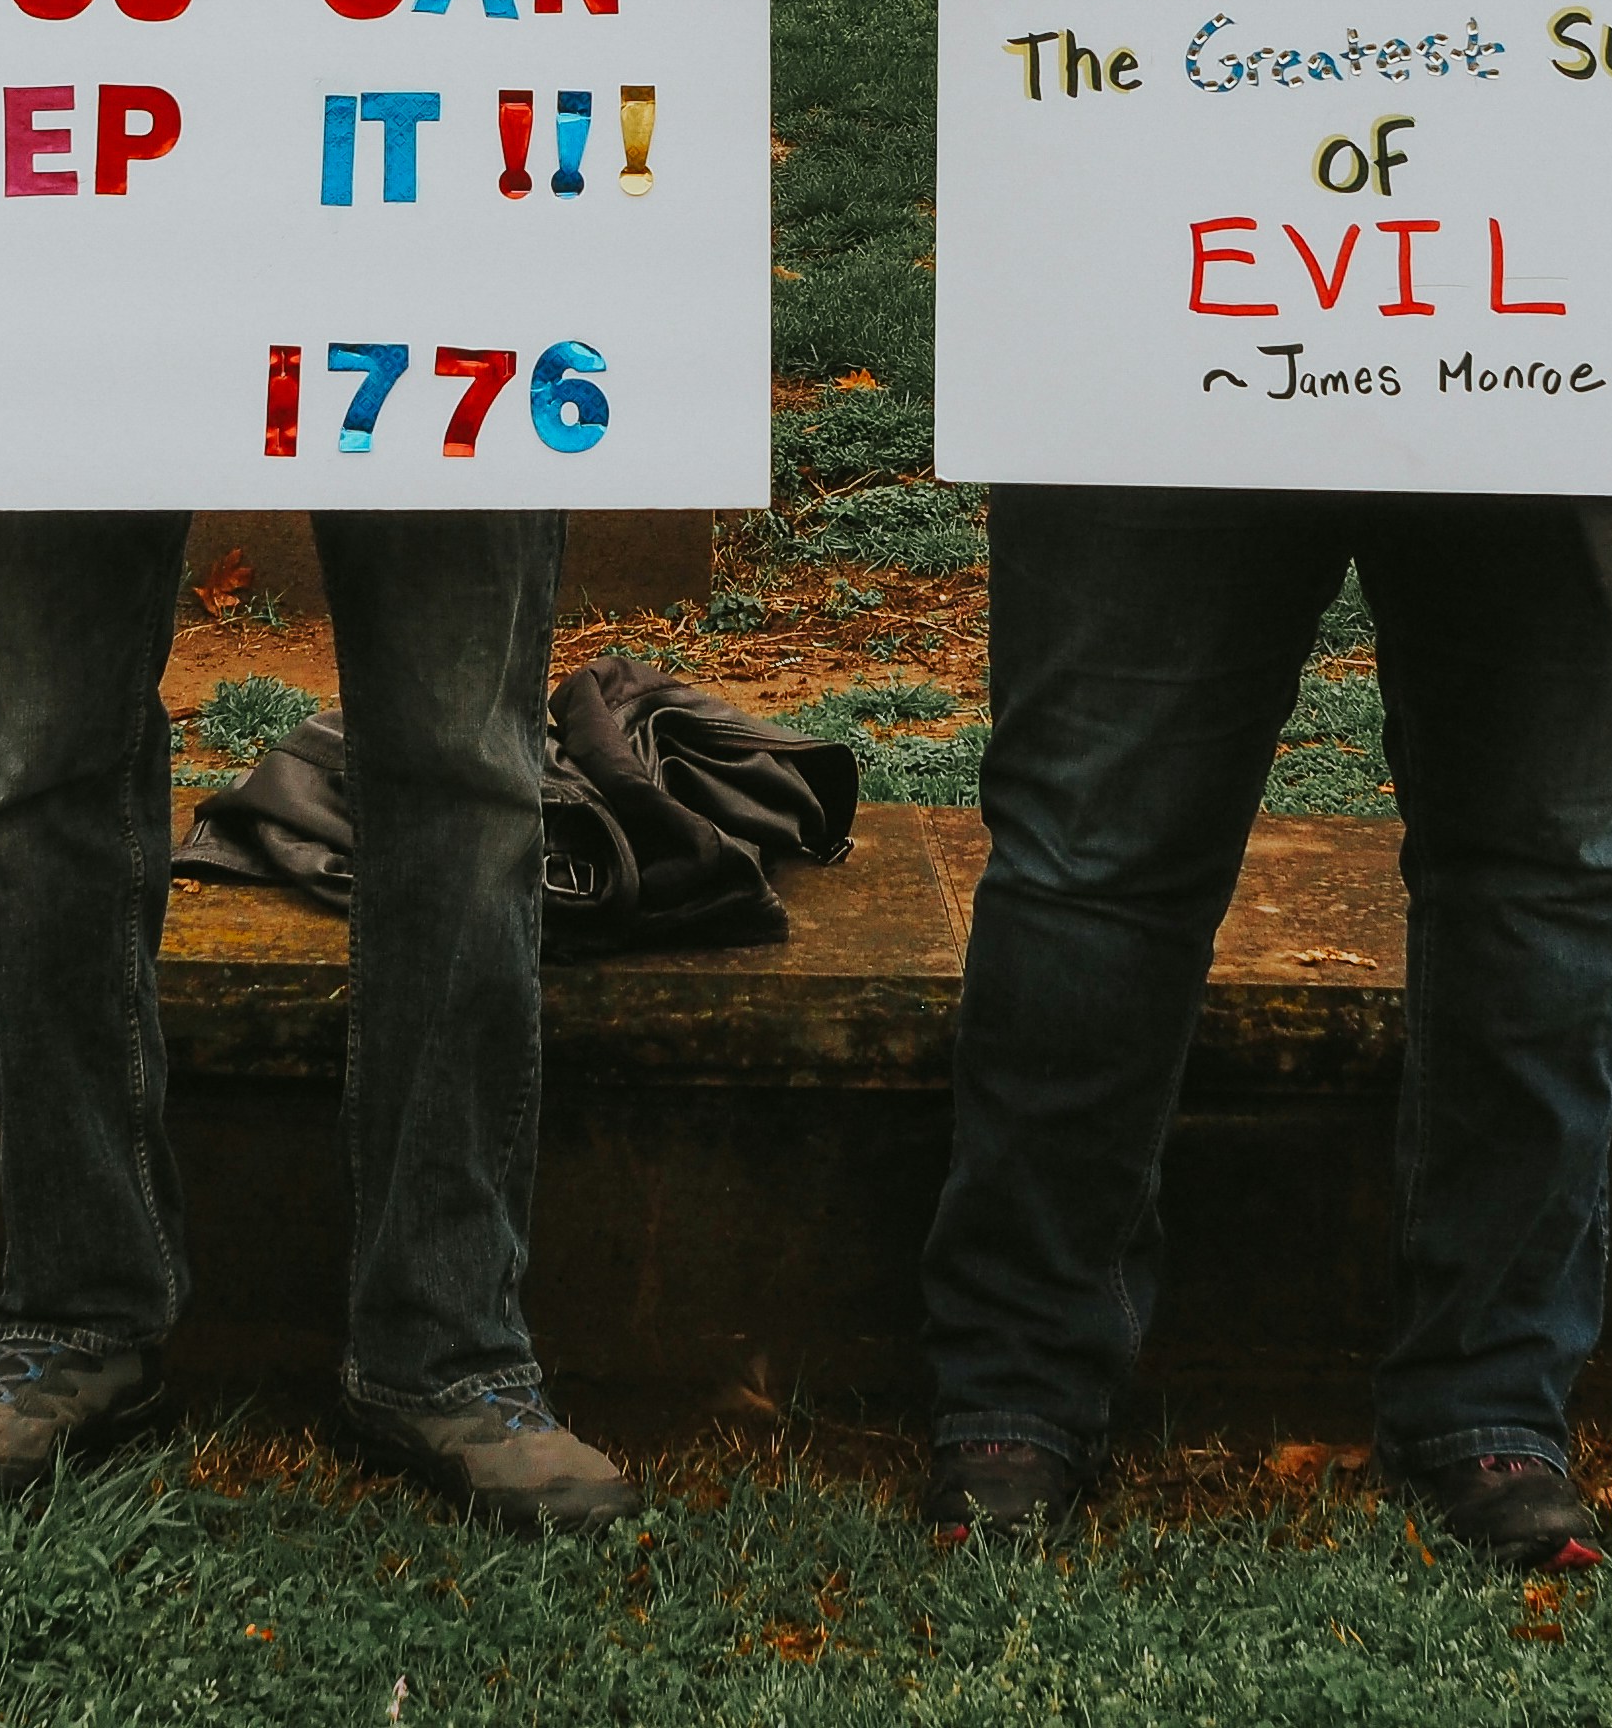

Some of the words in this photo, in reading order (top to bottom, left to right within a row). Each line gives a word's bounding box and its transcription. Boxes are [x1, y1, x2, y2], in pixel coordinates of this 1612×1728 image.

[1004, 28, 1143, 102] The
[1185, 12, 1506, 93] Greatest
[1189, 217, 1567, 317] EVIL
[264, 340, 610, 458] 1776
[1439, 351, 1606, 395] Monroe
